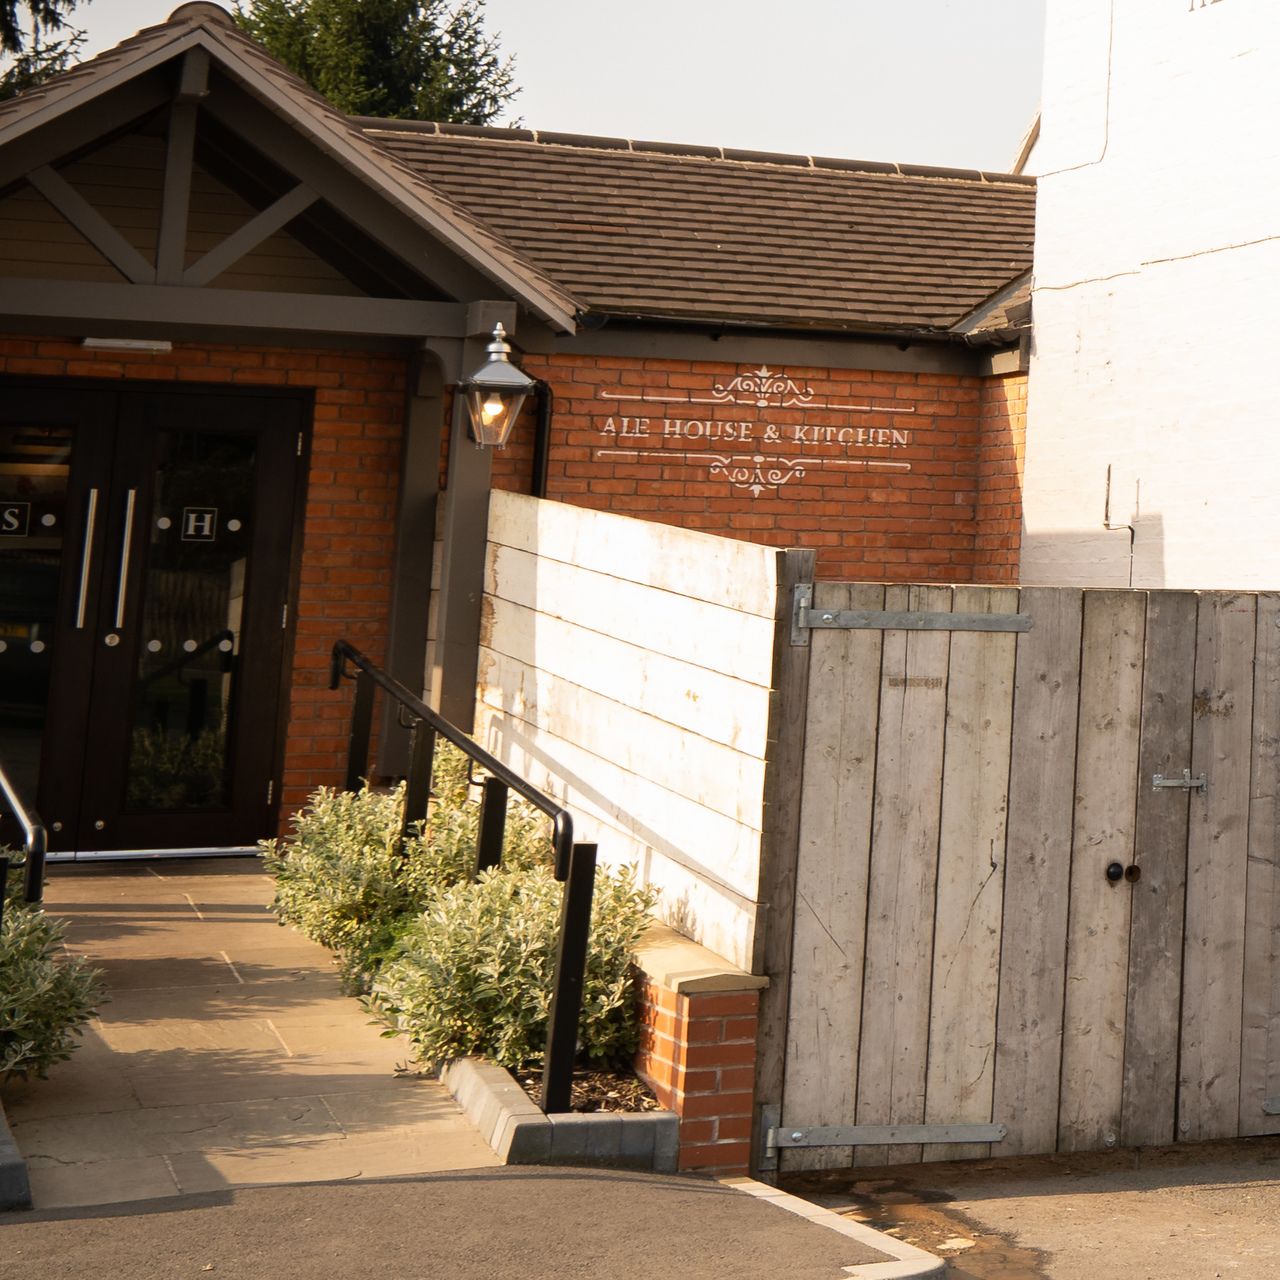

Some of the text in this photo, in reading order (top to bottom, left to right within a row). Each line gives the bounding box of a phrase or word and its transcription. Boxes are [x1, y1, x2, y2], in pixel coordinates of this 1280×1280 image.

[600, 417, 910, 448] ALE HOUSE & KITCHEN
[2, 508, 20, 531] S
[186, 513, 213, 535] H
